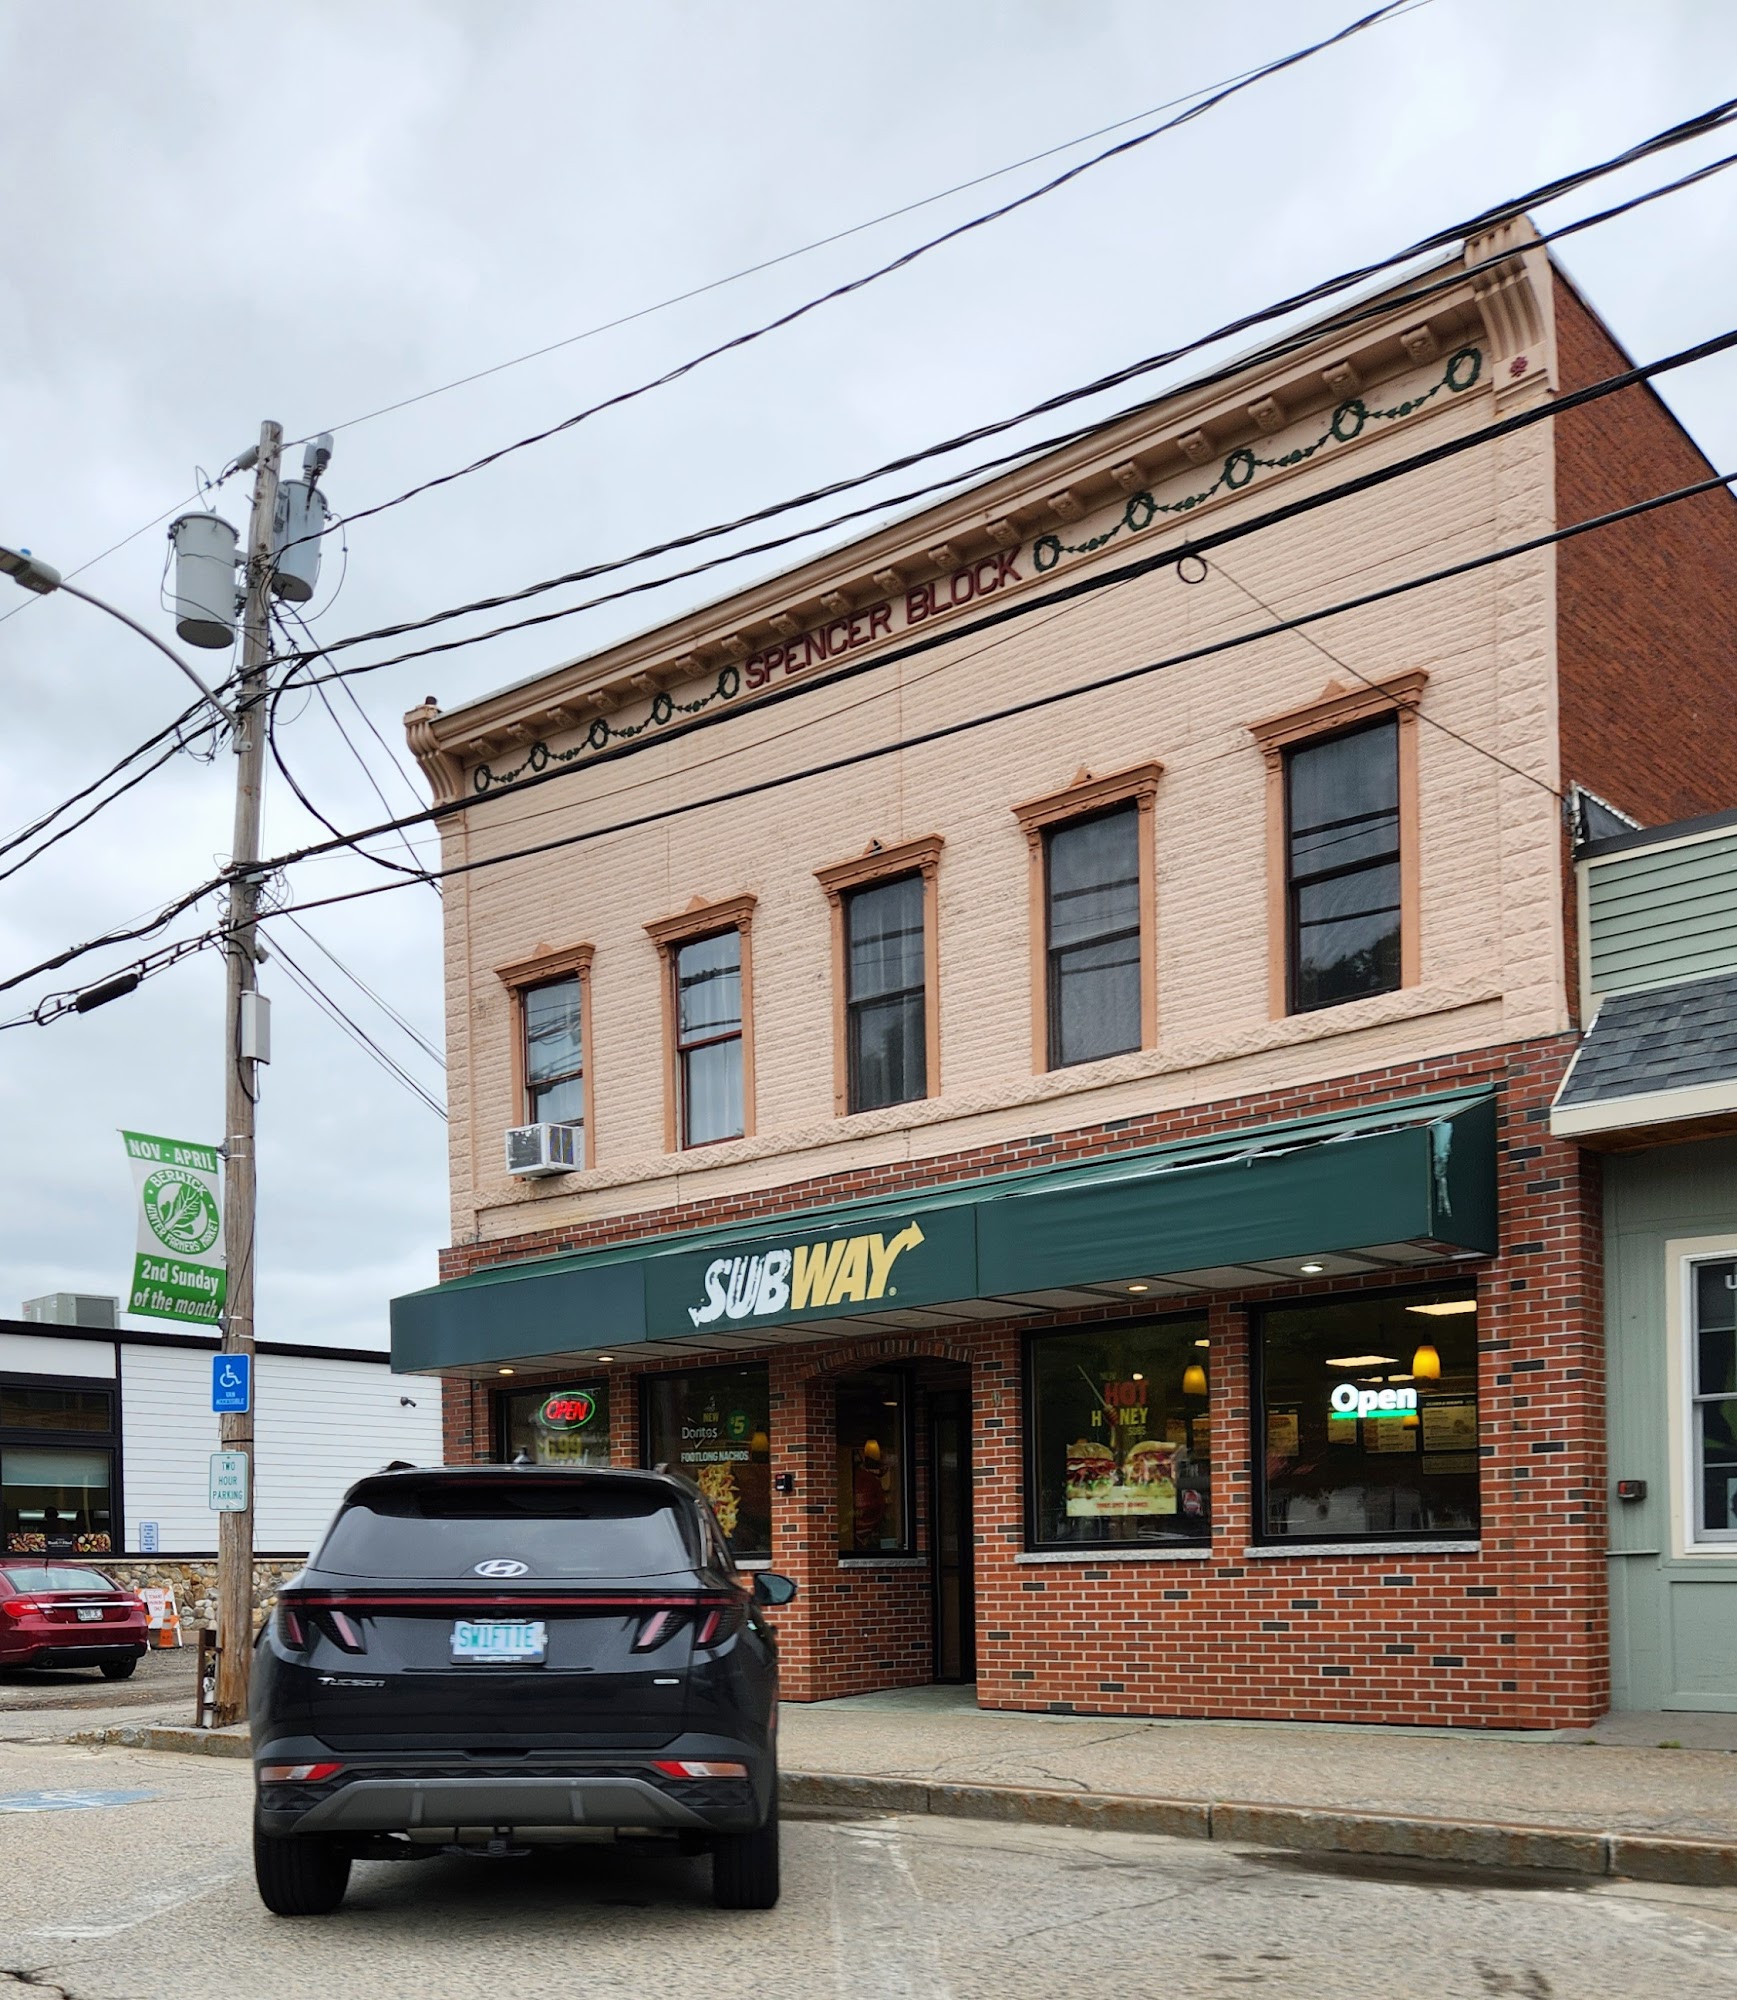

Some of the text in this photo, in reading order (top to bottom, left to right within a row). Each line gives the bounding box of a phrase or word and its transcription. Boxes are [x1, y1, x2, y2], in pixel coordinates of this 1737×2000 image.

[745, 545, 1022, 689] SPENCER BLOCK
[128, 1138, 161, 1160] NOV
[174, 1147, 216, 1171] APRIL
[150, 1168, 208, 1197] BERWICK
[145, 1202, 219, 1253] WINTER FARMERS MARKET
[141, 1259, 219, 1296] 2nd Sunday
[688, 1220, 925, 1328] SUBWAY
[133, 1288, 218, 1319] of the month
[1104, 1380, 1149, 1406] HOT
[1331, 1384, 1418, 1418] Open
[546, 1400, 589, 1421] OPEN
[703, 1412, 719, 1423] NEW
[1091, 1407, 1148, 1427] HNEY
[681, 1427, 718, 1439] Doritos
[222, 1461, 236, 1471] TWO
[681, 1450, 749, 1463] FOOTLONG NACHOS
[218, 1476, 238, 1486] HOUR
[212, 1490, 243, 1501] PARKING
[459, 1626, 535, 1648] SWIFTIE
